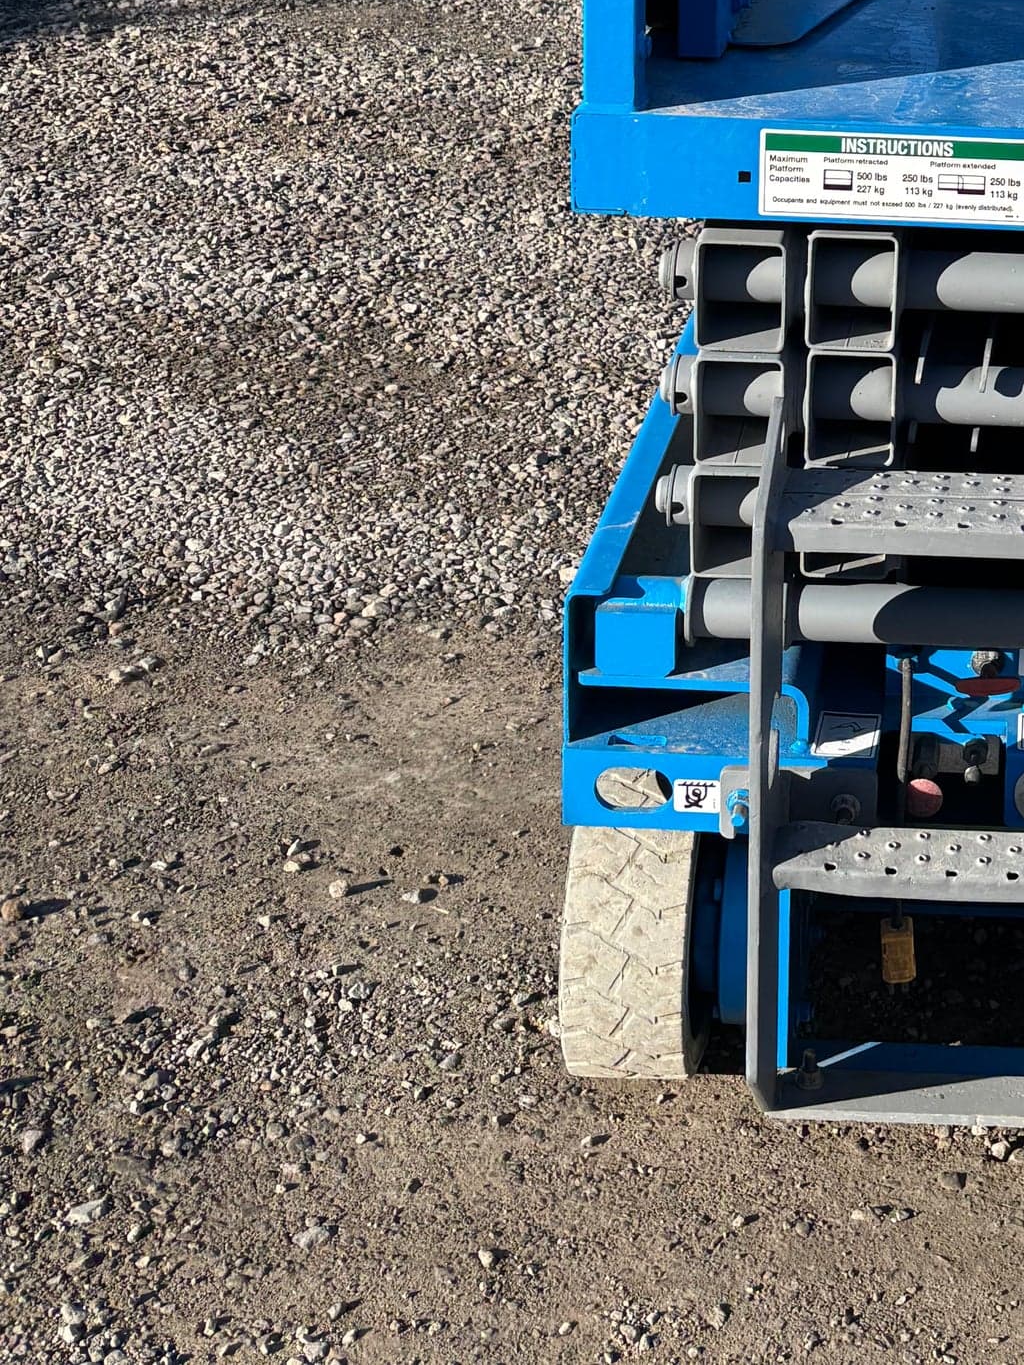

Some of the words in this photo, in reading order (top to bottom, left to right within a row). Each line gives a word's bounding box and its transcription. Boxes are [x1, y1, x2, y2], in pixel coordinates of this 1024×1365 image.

[841, 137, 955, 157] INSTRUCTIONS
[769, 154, 808, 164] Maximum
[823, 156, 854, 164] Platform
[856, 158, 888, 166] retracted
[769, 164, 804, 172] Platform
[962, 162, 996, 170] extended
[769, 174, 810, 184] Capacities
[856, 172, 873, 180] 500
[874, 172, 888, 181] lbs
[902, 174, 918, 182] 250
[920, 174, 933, 183] lbs
[990, 178, 1006, 186] 250
[1008, 178, 1021, 187] lbs
[856, 185, 872, 193] 227
[874, 186, 885, 196] kg
[905, 187, 920, 195] 113
[922, 188, 933, 198] kg
[772, 196, 804, 204] Occupants
[1007, 192, 1018, 201] kg
